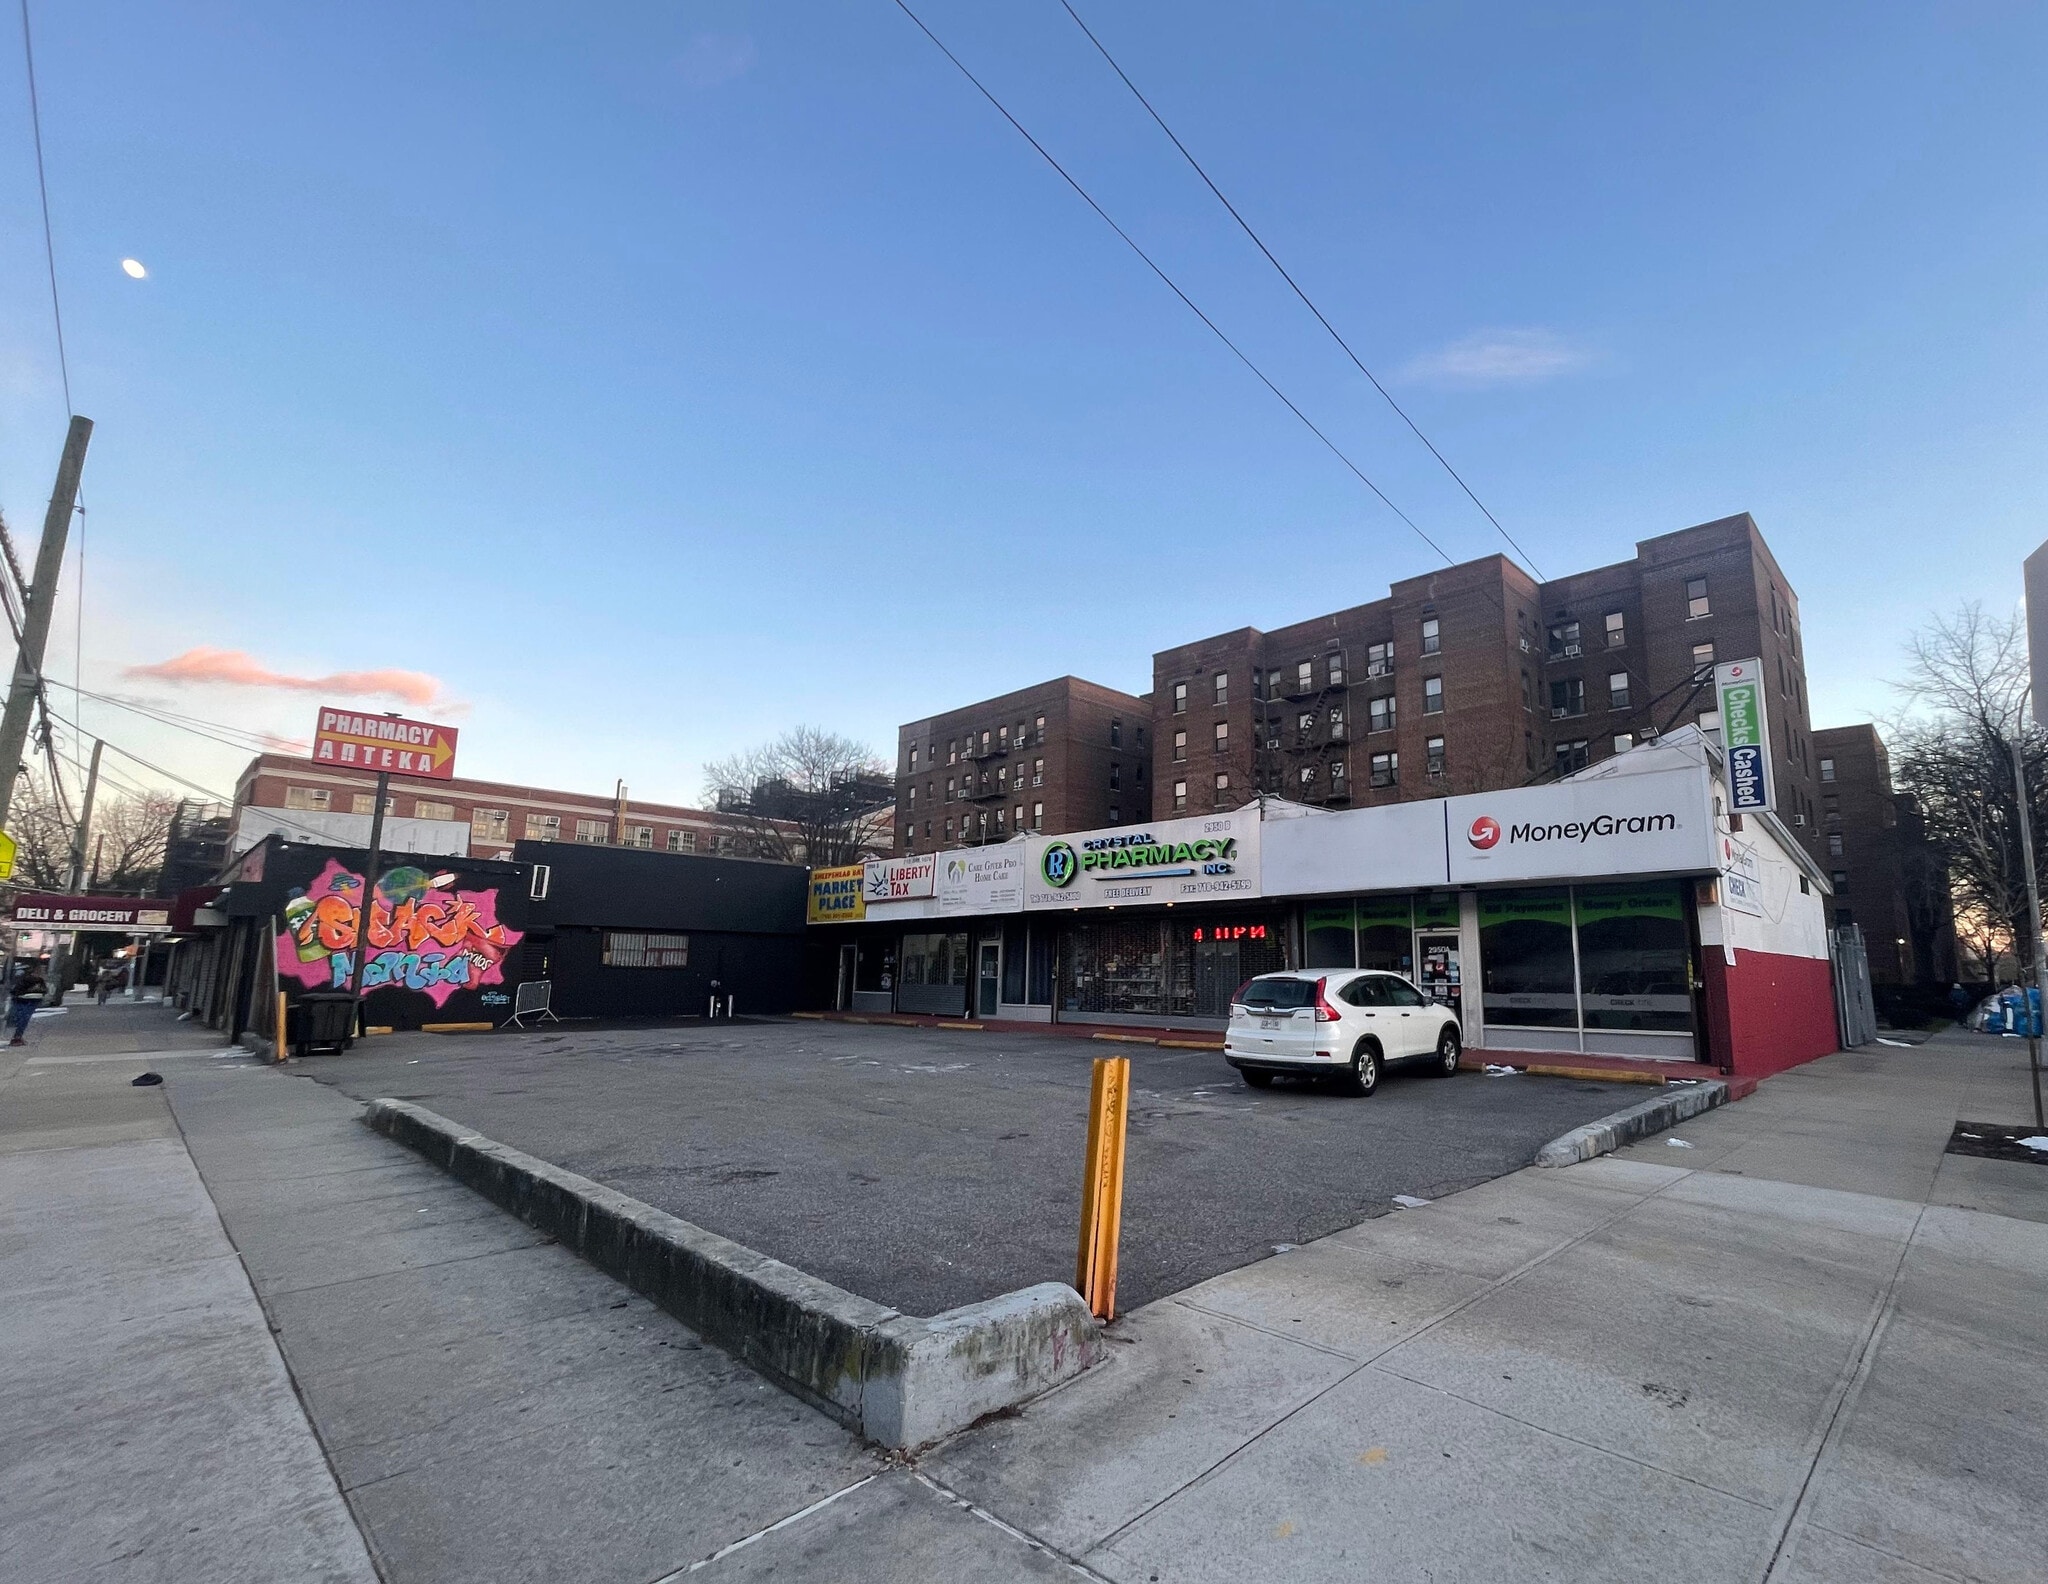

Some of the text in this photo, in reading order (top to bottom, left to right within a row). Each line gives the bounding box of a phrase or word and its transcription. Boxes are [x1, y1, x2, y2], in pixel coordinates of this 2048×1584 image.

[1728, 689, 1753, 745] Checks
[323, 712, 434, 746] PHARMACY
[1733, 748, 1760, 806] Cashed
[1204, 822, 1224, 832] 2950
[1510, 813, 1676, 844] MoneyGram
[1082, 832, 1155, 850] CRYSTAL
[890, 865, 931, 881] LIBERTY
[890, 882, 909, 897] TAX
[1104, 886, 1152, 898] FREE DELIVERY
[818, 896, 856, 911] PLACE
[17, 908, 133, 922] DELI & GROCERY
